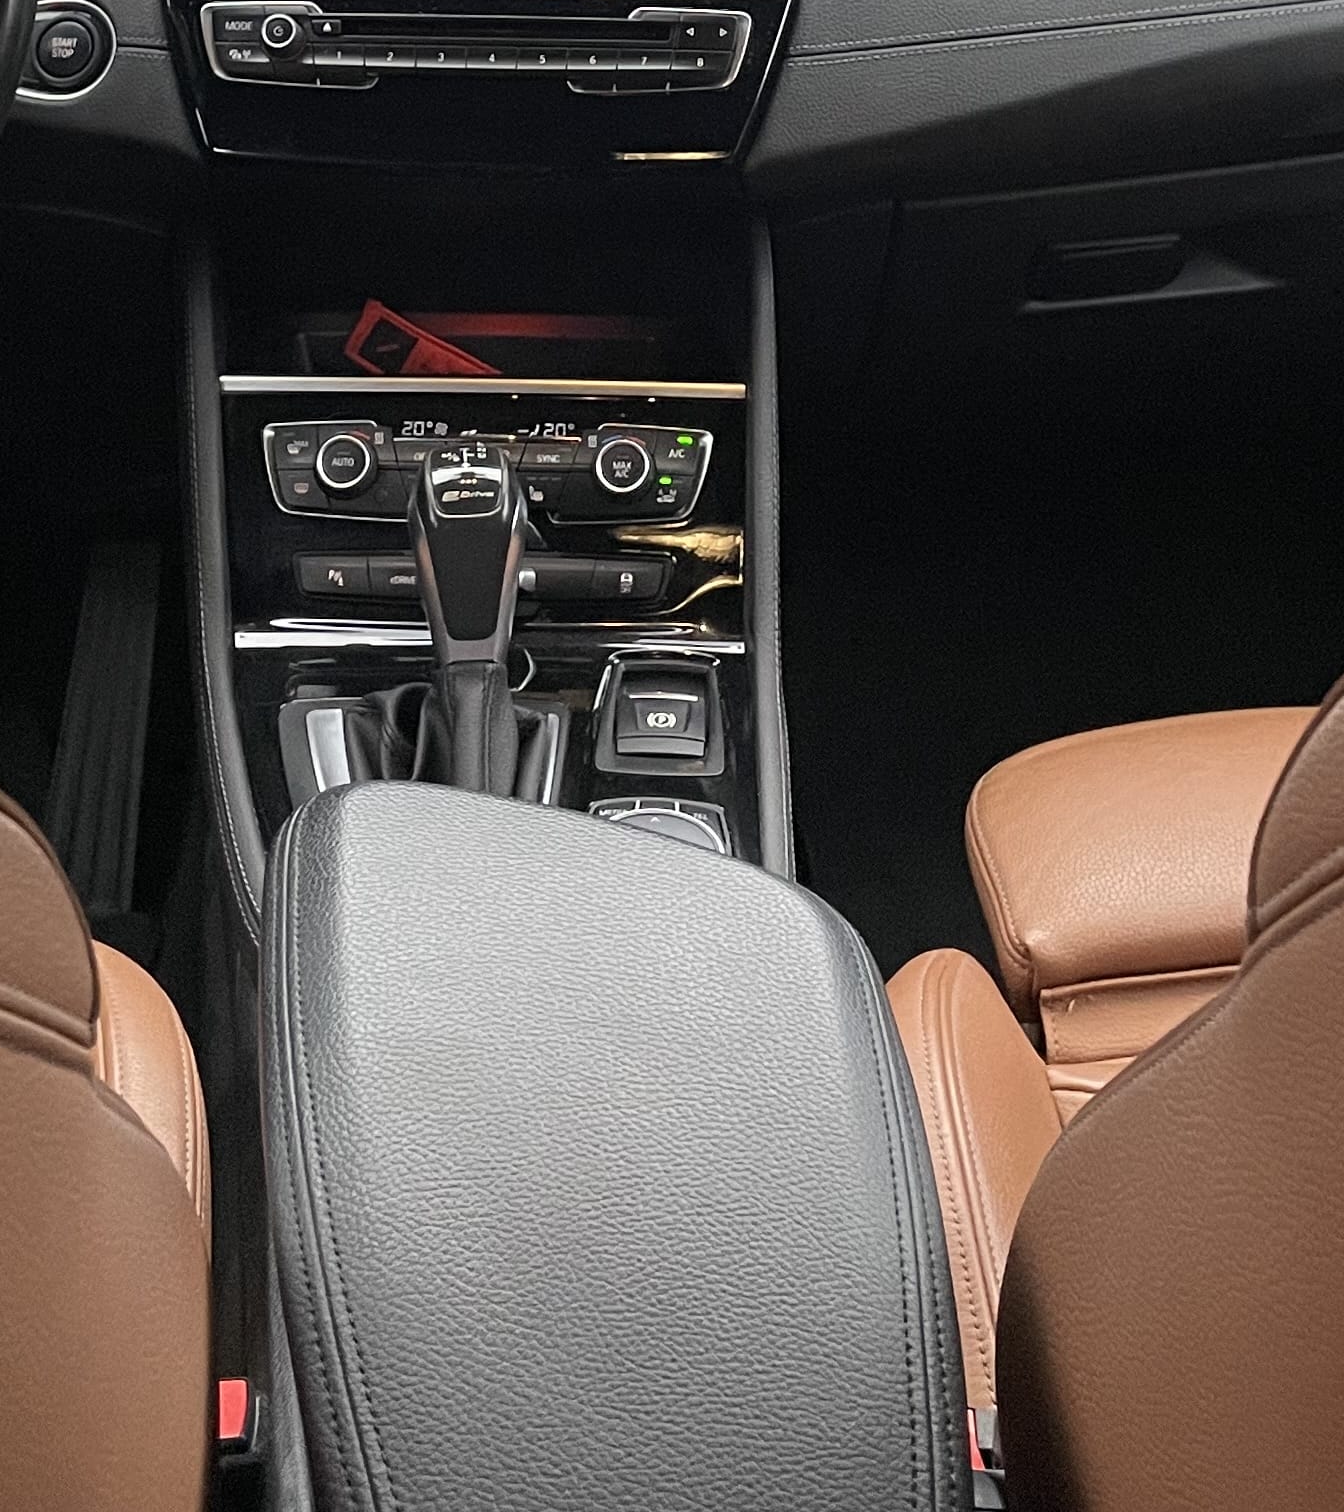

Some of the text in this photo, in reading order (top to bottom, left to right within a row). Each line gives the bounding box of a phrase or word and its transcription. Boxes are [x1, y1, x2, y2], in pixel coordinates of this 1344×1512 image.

[225, 20, 254, 31] MODE
[51, 37, 77, 48] START
[51, 48, 74, 58] STOP
[336, 50, 704, 67] 1 2 3 4 5 6 7 8
[668, 448, 686, 459] A/C
[331, 457, 355, 467] AUTO
[536, 454, 561, 464] SYNC
[612, 461, 632, 470] MAX
[614, 469, 630, 479] A/C
